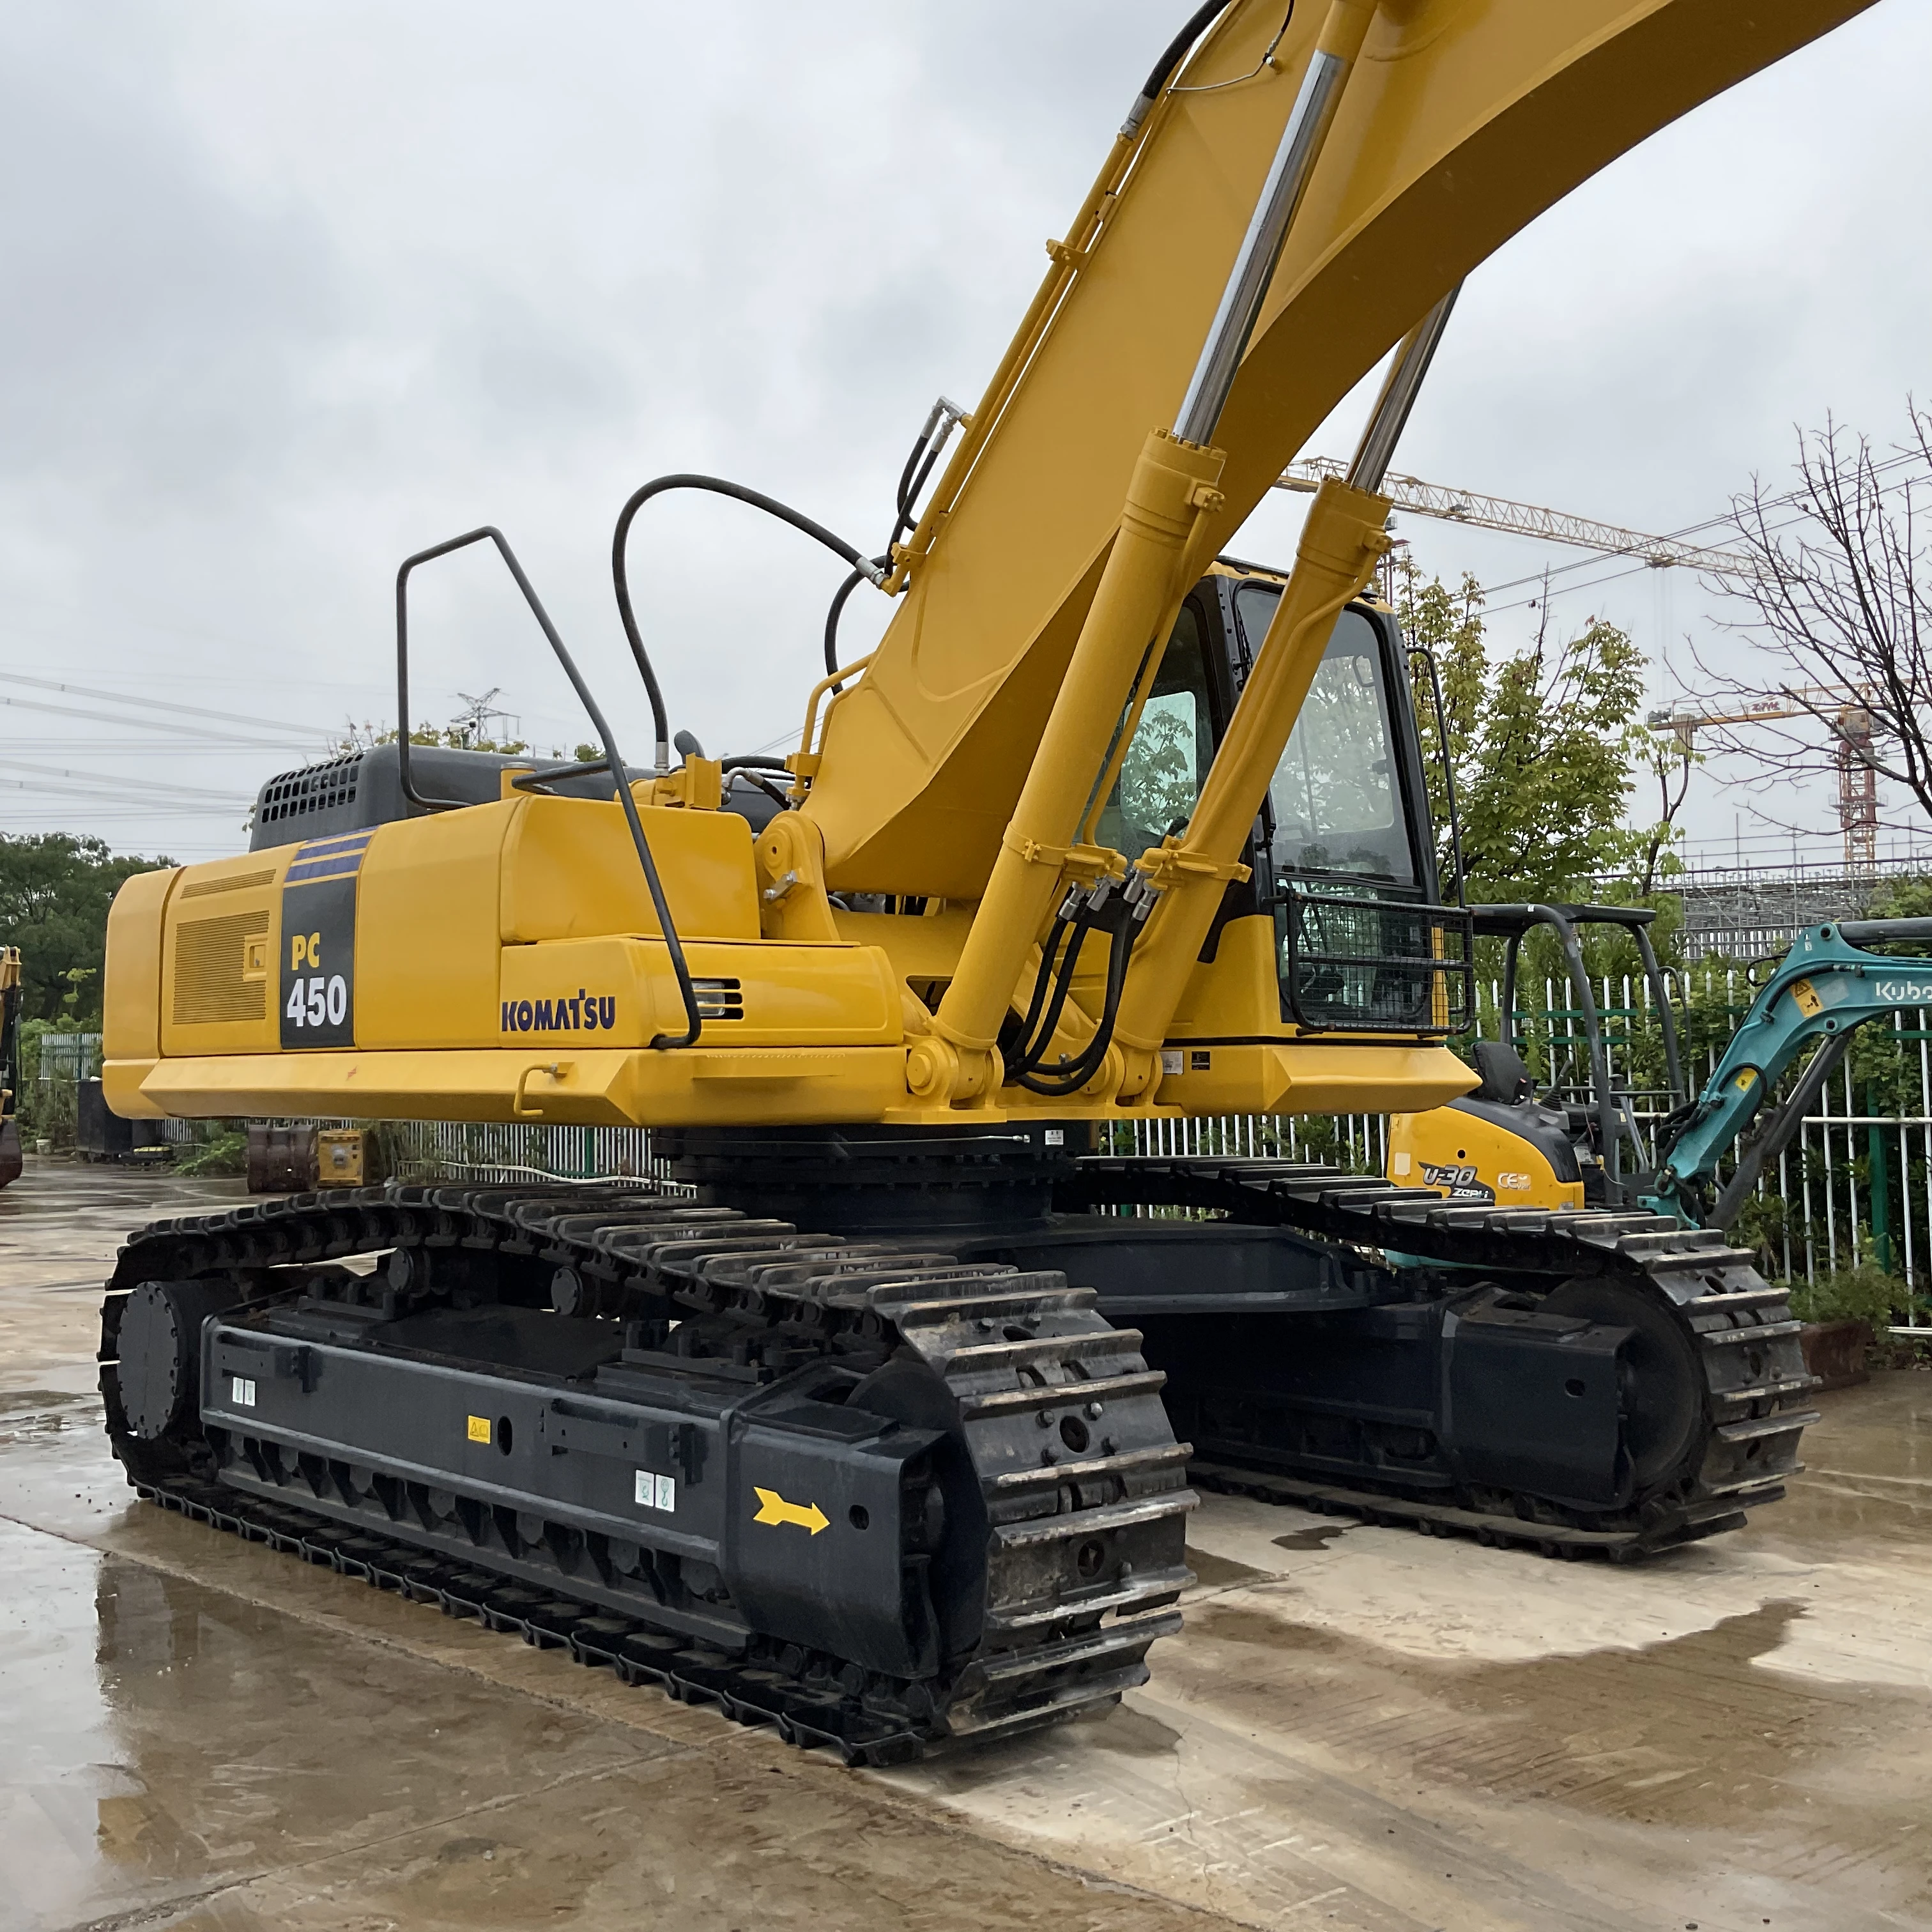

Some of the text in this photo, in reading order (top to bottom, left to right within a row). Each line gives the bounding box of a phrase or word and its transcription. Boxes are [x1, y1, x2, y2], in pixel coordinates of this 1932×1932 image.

[292, 932, 320, 970] PC
[287, 975, 347, 1027] 450
[502, 988, 615, 1032] KOMATSU
[1423, 1165, 1477, 1186] U-30
[1498, 1173, 1517, 1189] CE
